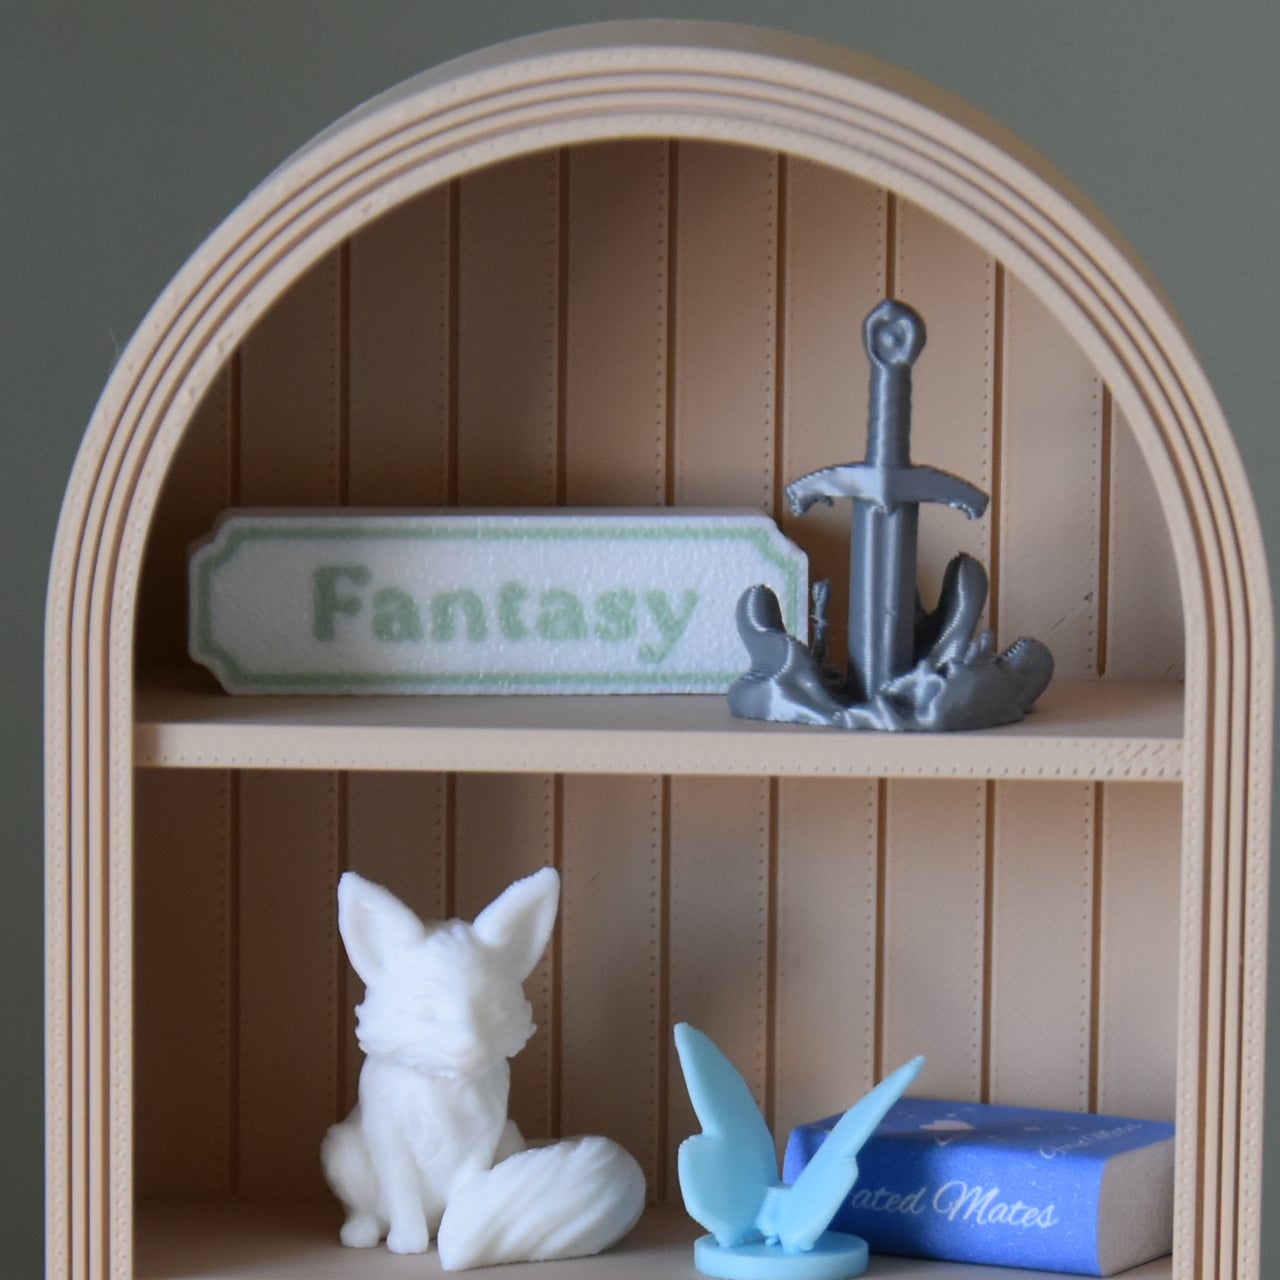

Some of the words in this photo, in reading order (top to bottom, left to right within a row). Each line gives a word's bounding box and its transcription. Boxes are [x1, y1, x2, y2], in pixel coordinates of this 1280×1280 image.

[312, 564, 699, 664] Fantasy
[849, 1186, 926, 1214] ated
[933, 1181, 1058, 1229] Mates
